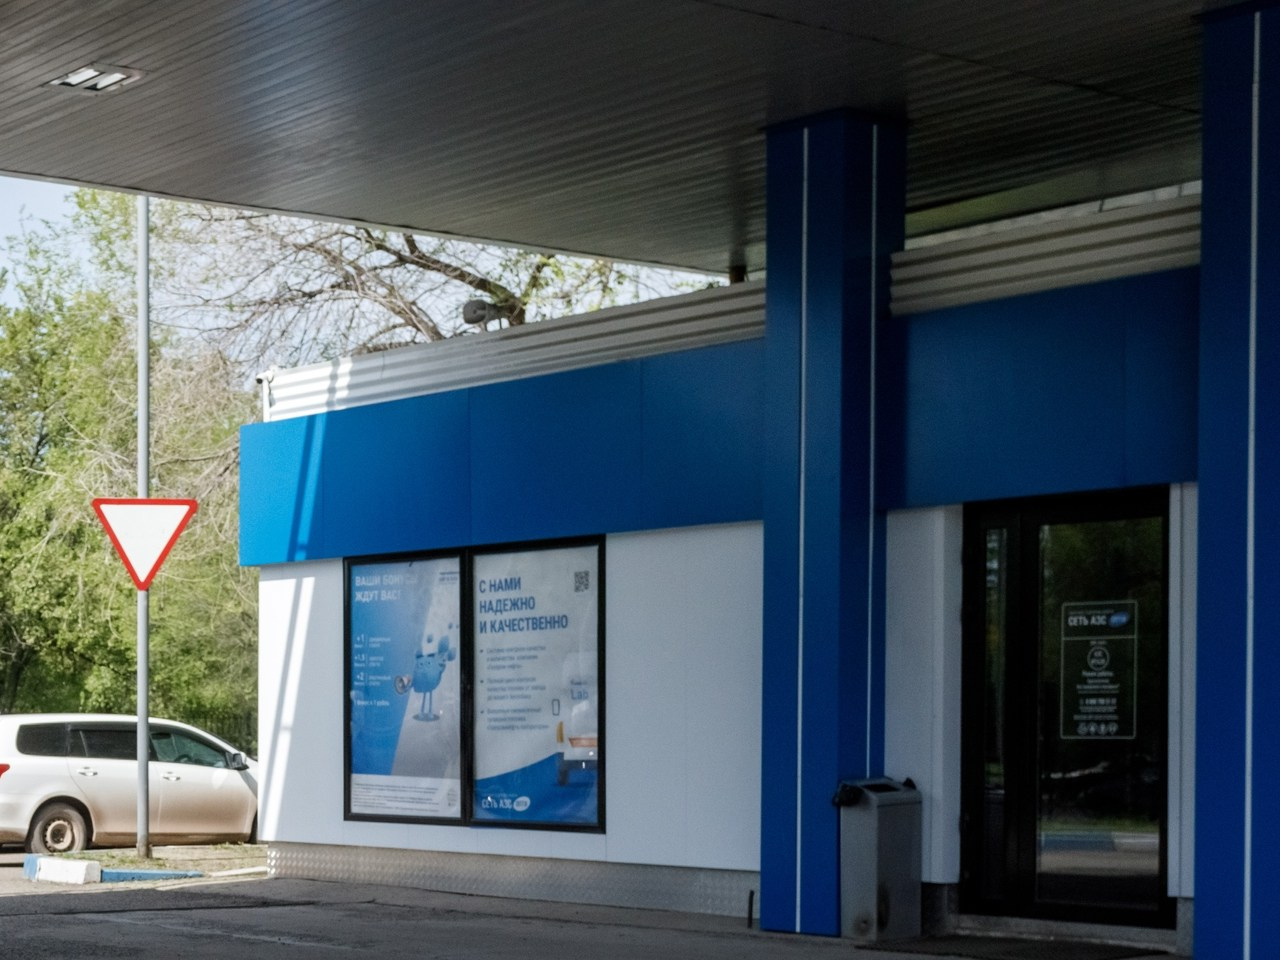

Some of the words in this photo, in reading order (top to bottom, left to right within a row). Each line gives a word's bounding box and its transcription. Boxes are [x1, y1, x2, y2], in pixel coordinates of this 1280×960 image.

[355, 575, 381, 587] ВАШИ
[479, 580, 487, 594] С
[489, 577, 522, 592] НАМИ
[354, 590, 379, 603] ЖДУТ
[479, 596, 536, 615] НАДЕЖНО
[479, 621, 488, 634] И
[490, 614, 569, 634] КАЧЕСТВЕННО
[1067, 615, 1089, 626] СЕТЬ
[1090, 614, 1107, 625] АЗС
[570, 688, 589, 700] Lab
